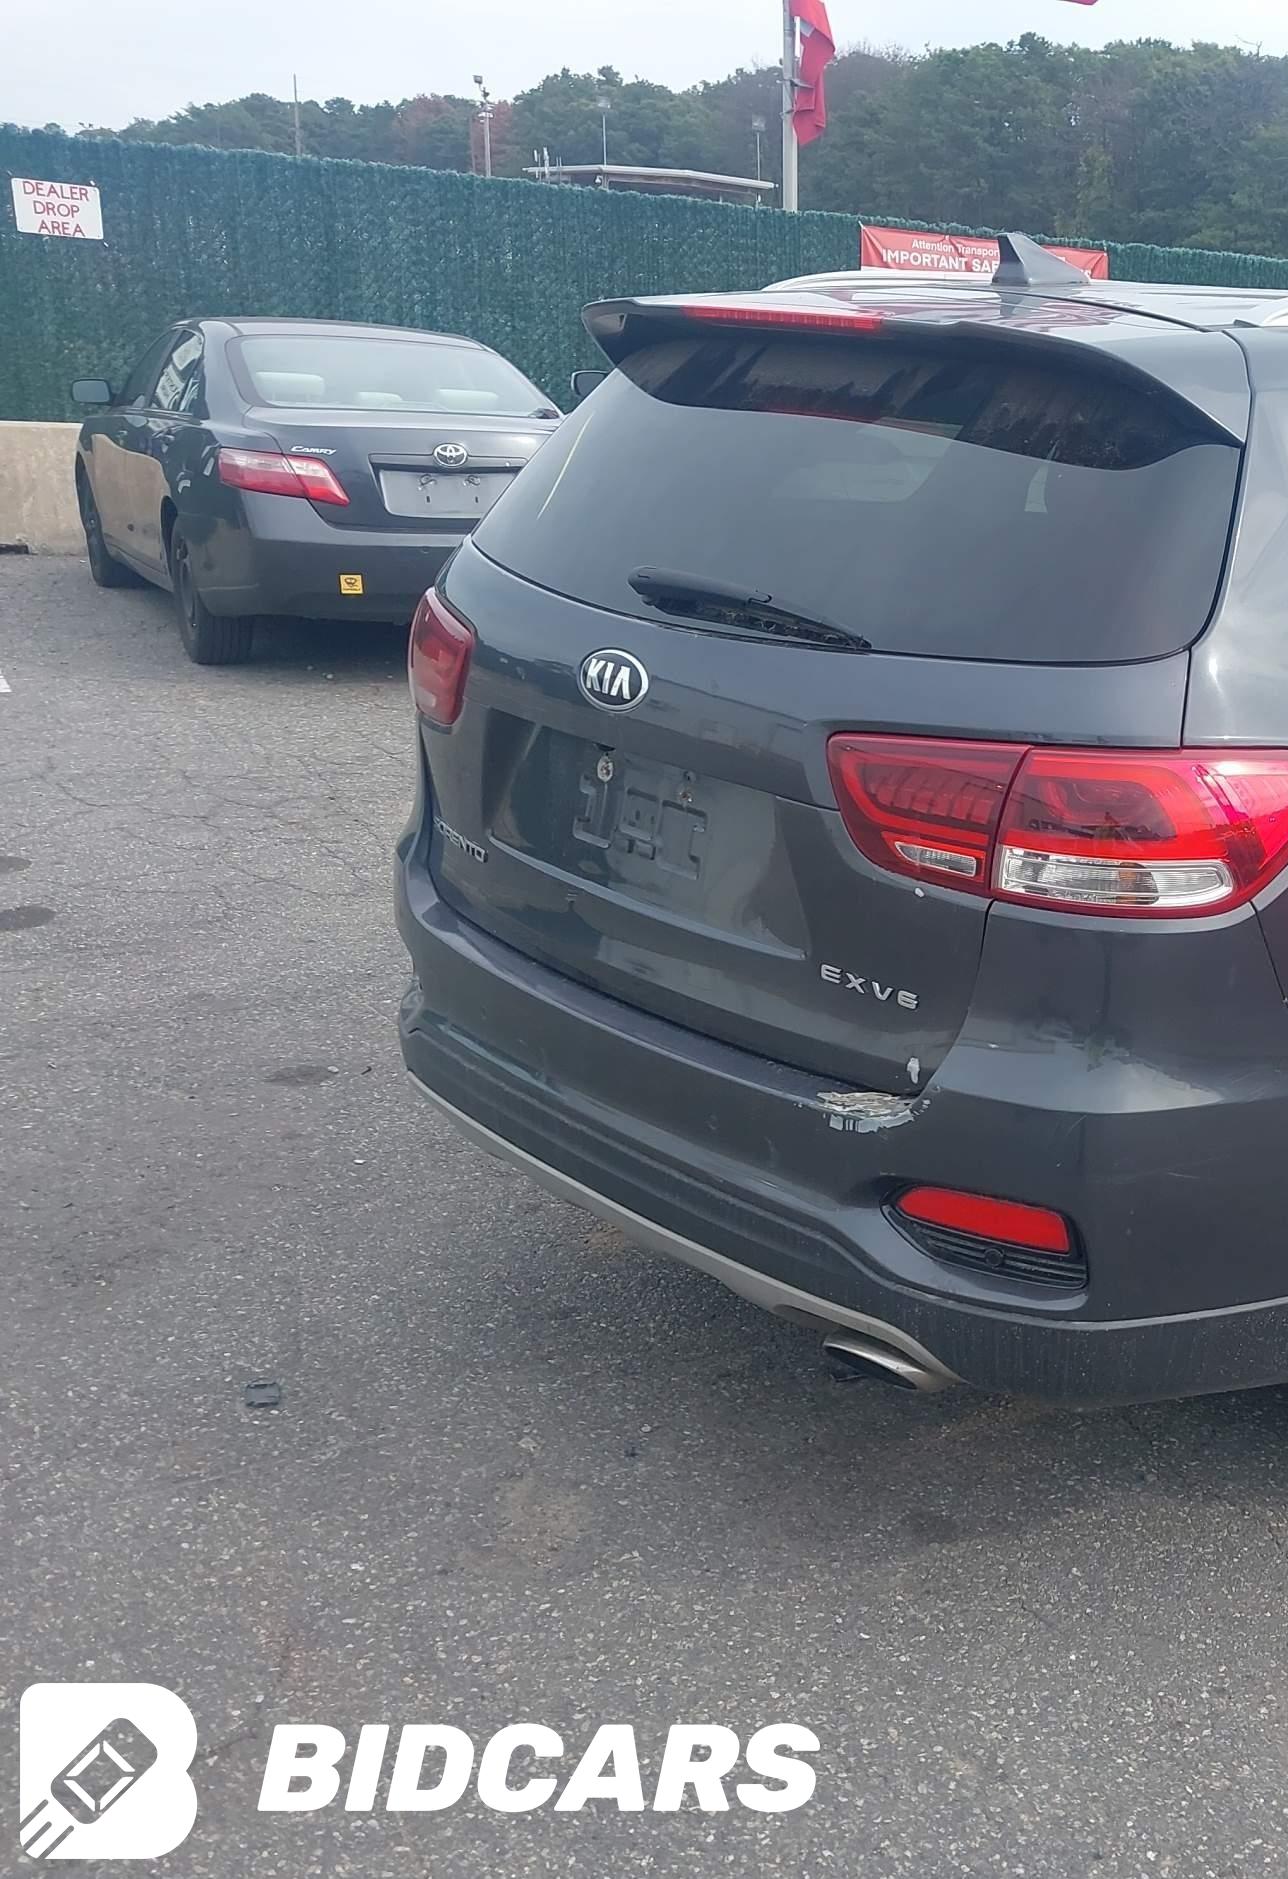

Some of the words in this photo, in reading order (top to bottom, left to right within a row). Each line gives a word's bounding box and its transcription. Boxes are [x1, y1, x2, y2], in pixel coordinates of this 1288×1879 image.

[22, 180, 89, 201] DEALER
[33, 200, 80, 218] DROP
[38, 219, 86, 237] AREA
[911, 239, 955, 253] Attention
[881, 247, 969, 271] IMPORTANT
[585, 658, 631, 700] KIA
